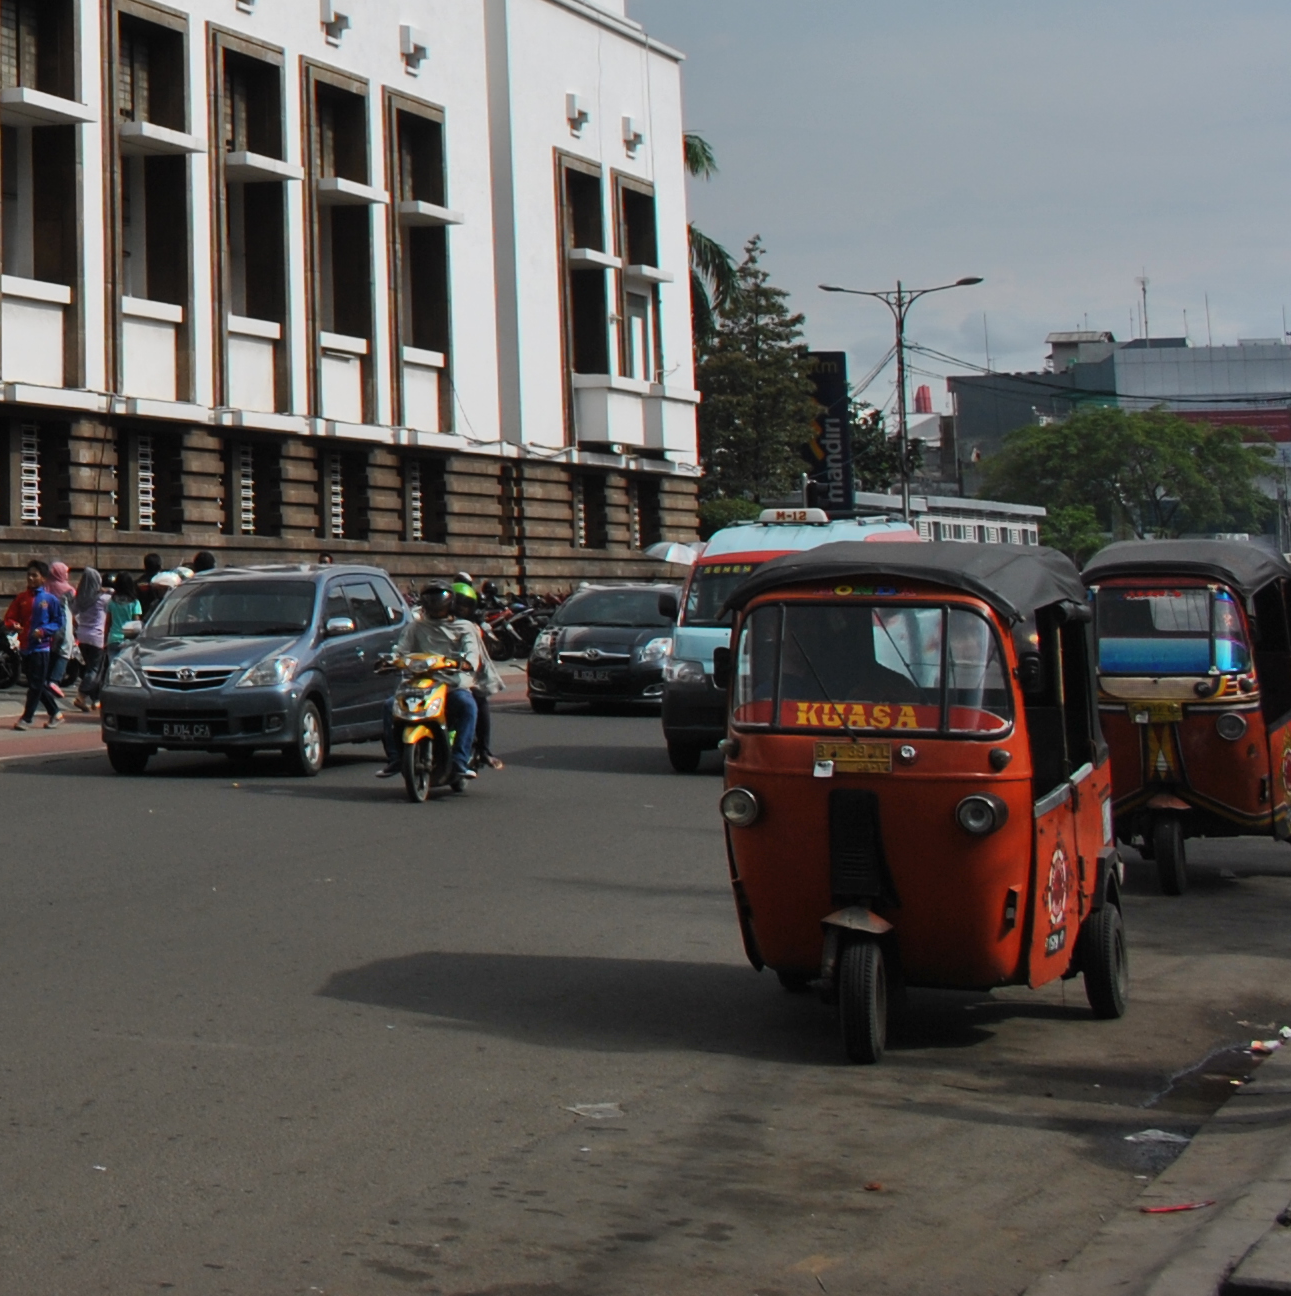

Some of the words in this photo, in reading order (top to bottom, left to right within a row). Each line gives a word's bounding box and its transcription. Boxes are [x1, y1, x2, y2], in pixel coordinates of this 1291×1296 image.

[821, 417, 844, 503] mandiri
[775, 510, 807, 521] M-12
[795, 702, 919, 728] KUASA
[163, 723, 170, 735] B
